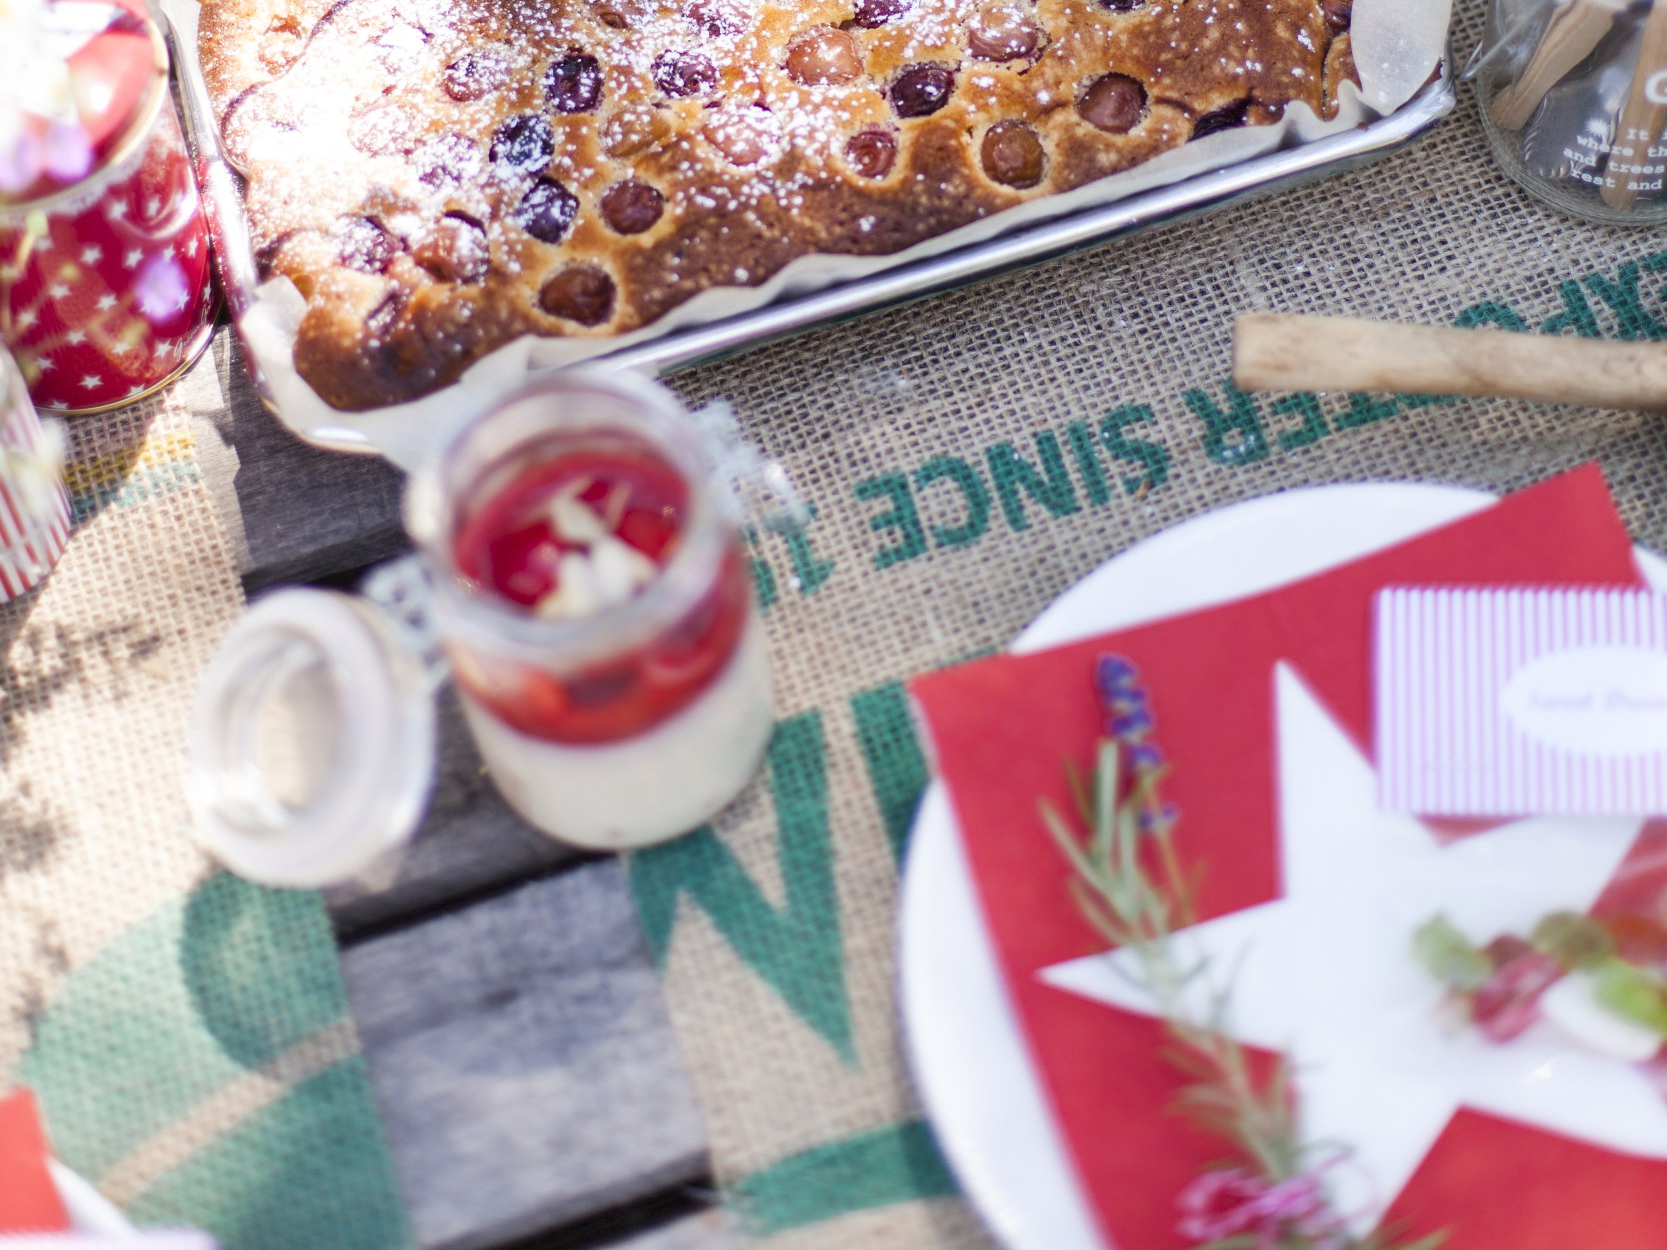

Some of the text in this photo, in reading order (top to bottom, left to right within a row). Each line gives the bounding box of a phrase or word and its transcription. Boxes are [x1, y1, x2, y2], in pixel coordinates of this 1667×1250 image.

[1576, 135, 1634, 156] where
[1563, 148, 1665, 174] and trees
[1570, 169, 1663, 190] rest and
[852, 402, 1171, 572] SINCE
